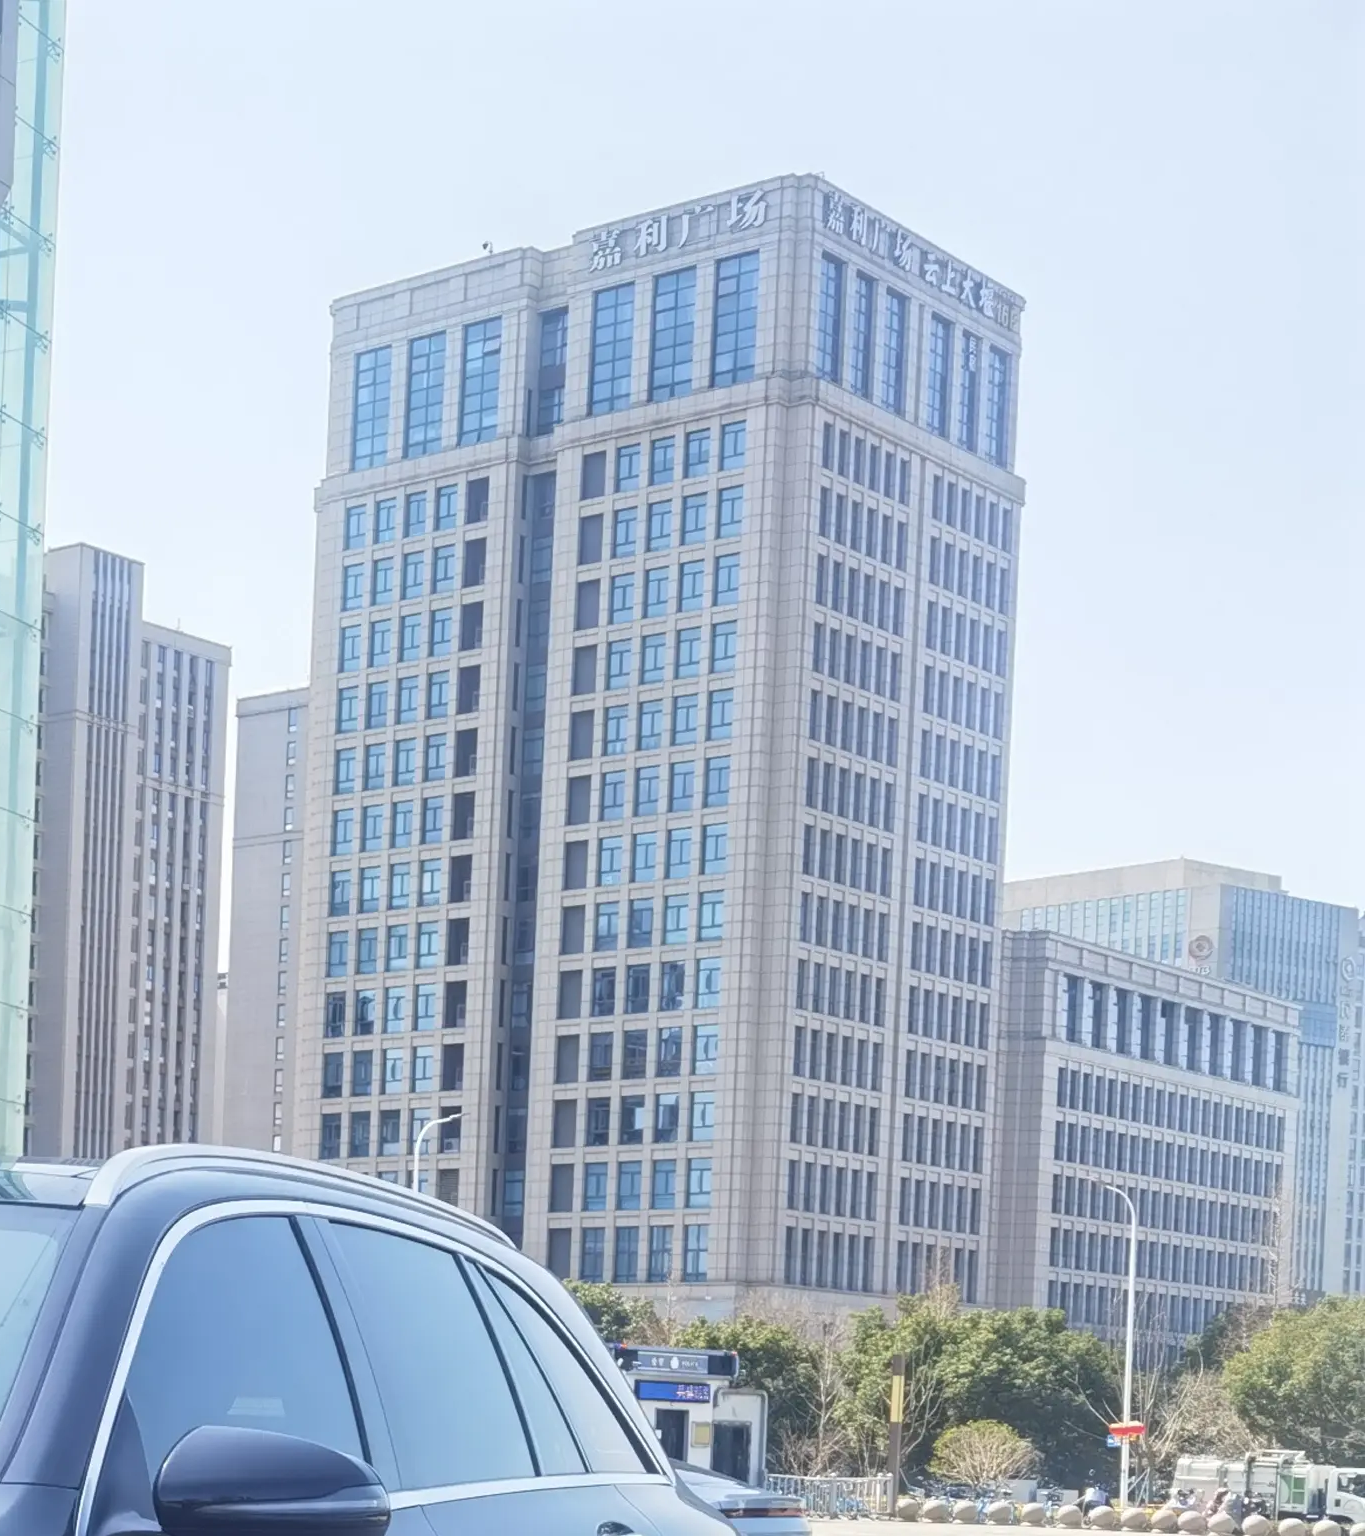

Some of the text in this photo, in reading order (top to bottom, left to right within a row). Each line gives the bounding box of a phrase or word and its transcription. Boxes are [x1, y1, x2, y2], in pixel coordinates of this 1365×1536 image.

[589, 189, 768, 273] 嘉利广场
[826, 191, 914, 272] 嘉利广场
